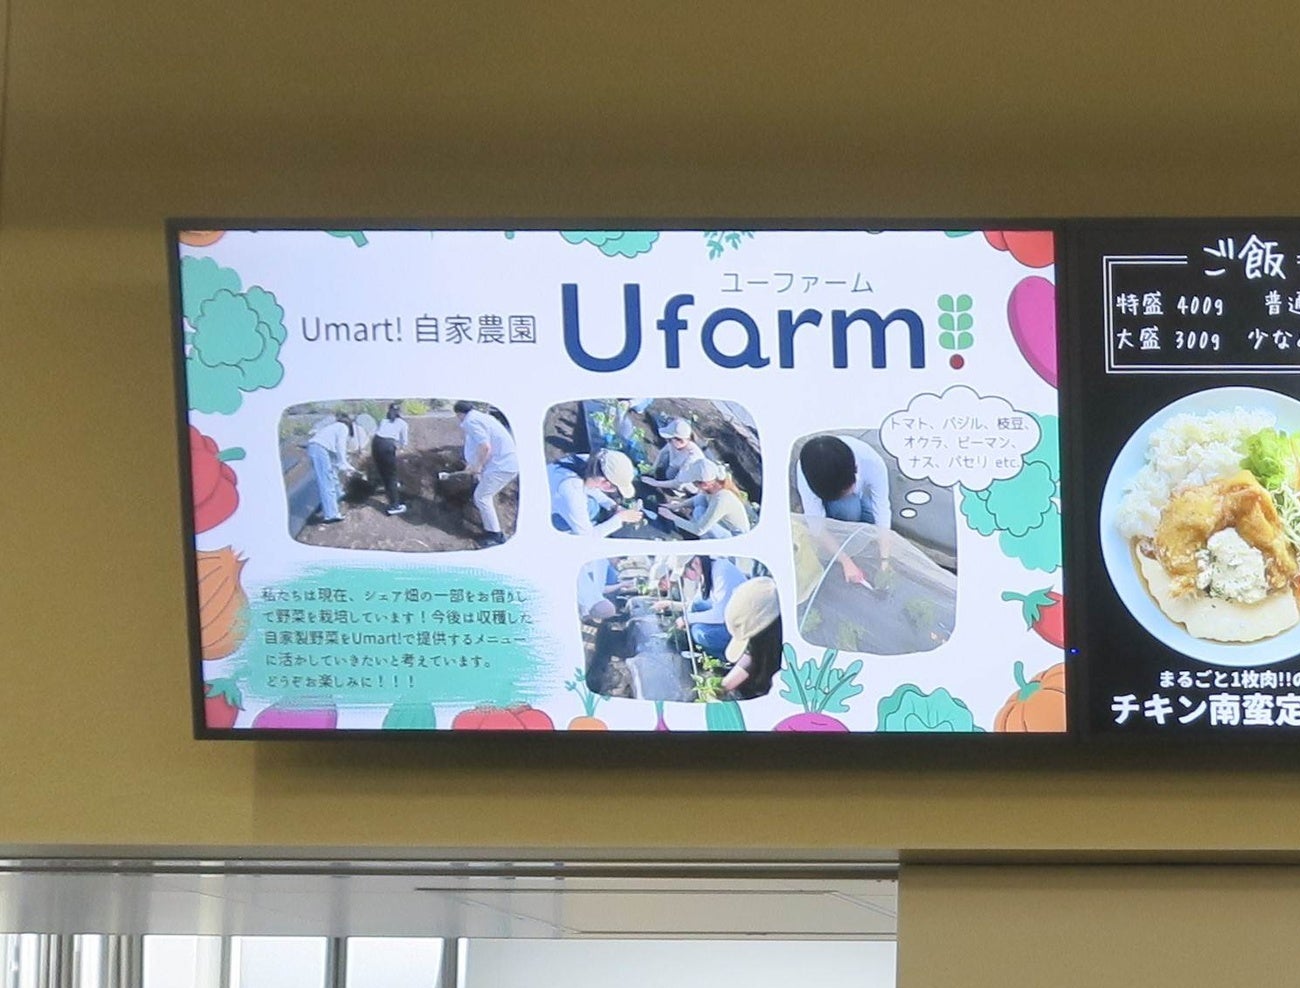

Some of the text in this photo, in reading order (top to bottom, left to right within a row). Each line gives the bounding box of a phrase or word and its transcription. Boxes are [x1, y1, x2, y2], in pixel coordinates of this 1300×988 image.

[1203, 234, 1286, 279] ご飯
[721, 272, 874, 293] ユーファーム
[1115, 291, 1224, 315] 特盛 400g
[300, 314, 537, 345] Umart! 自家農園
[1116, 325, 1220, 350] 大盛 300g
